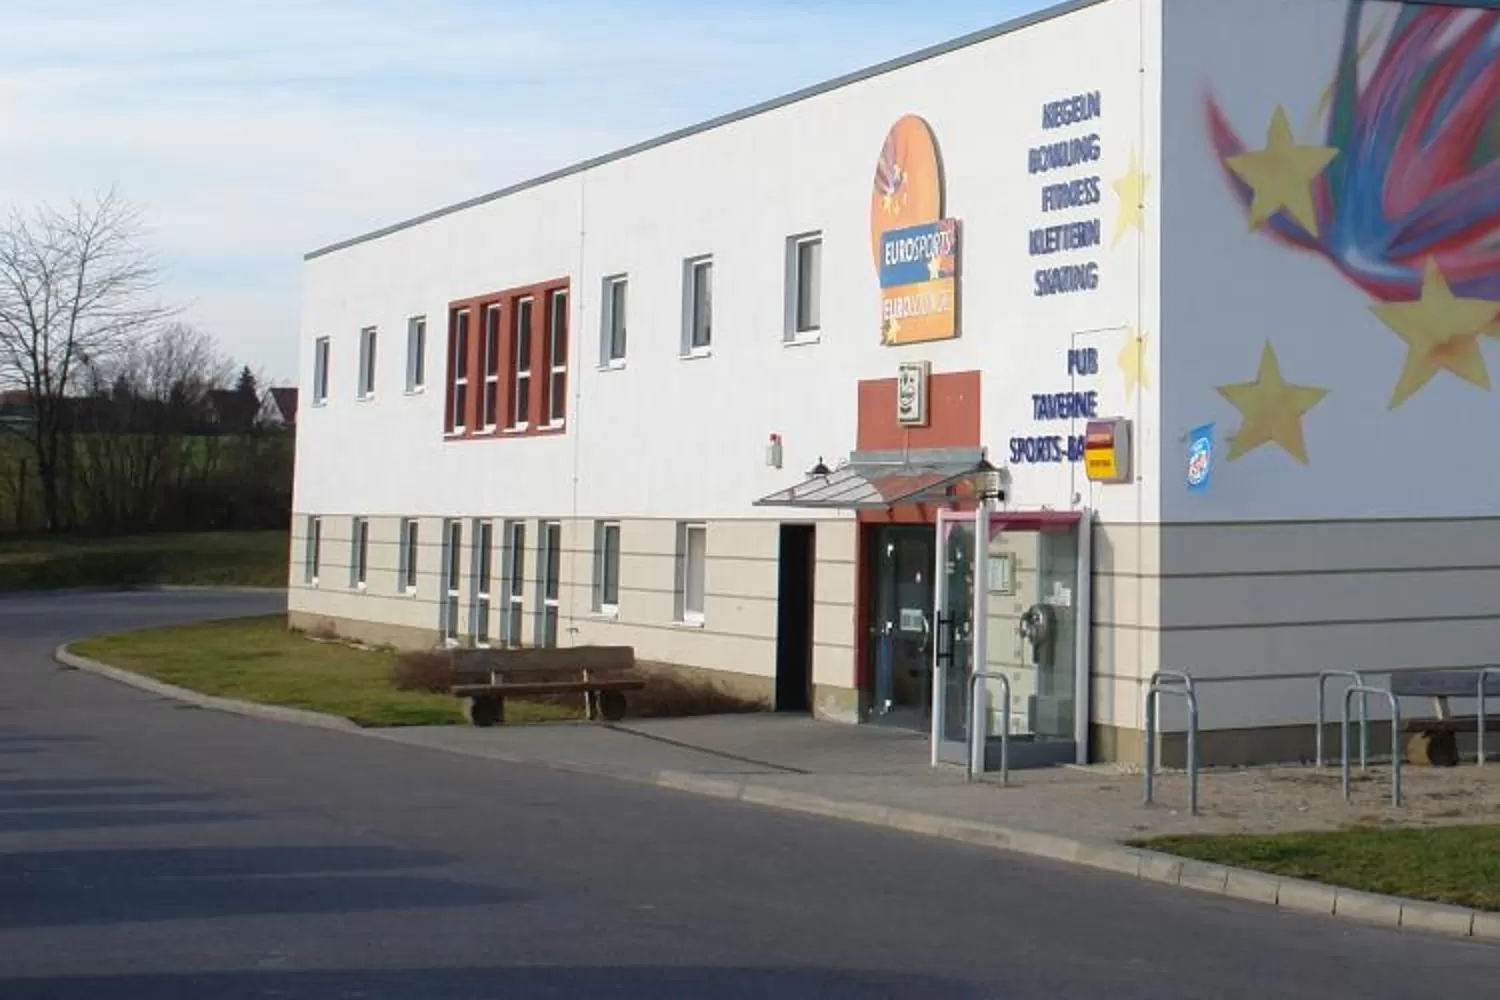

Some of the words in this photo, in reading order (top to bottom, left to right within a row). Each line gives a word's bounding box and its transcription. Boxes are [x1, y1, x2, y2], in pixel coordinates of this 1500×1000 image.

[1029, 134, 1101, 174] BOWLING
[1042, 176, 1101, 212] FITNESS
[1030, 219, 1101, 256] KLETTERN
[1035, 262, 1099, 296] SKATING
[1068, 347, 1098, 376] PUB
[1032, 390, 1098, 420] TAVERNE
[1009, 435, 1085, 463] SPORTS-BA
